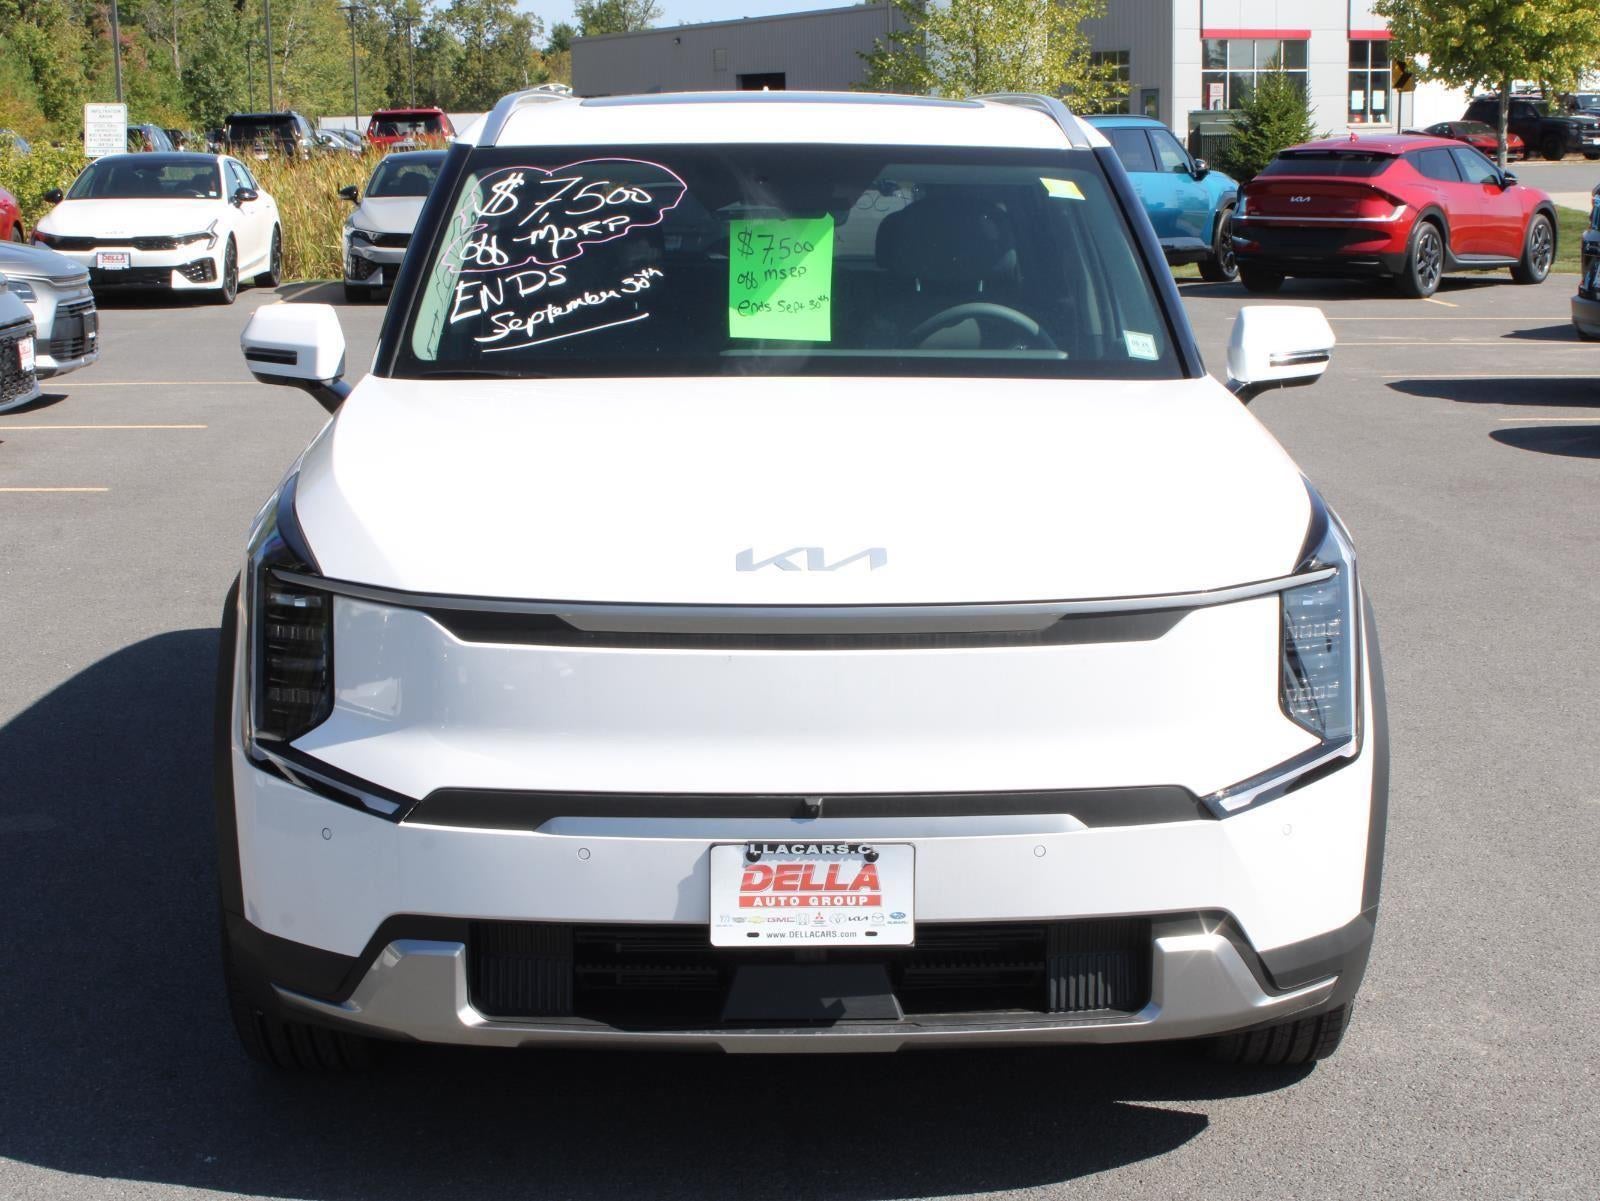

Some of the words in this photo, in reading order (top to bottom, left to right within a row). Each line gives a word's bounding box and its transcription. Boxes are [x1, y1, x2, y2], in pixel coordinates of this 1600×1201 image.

[449, 264, 568, 325] ENDS
[736, 546, 888, 572] KIA
[740, 863, 881, 893] DELLA
[752, 895, 800, 907] AUTO
[808, 895, 869, 907] GROUP
[766, 930, 857, 939] www.DELLACARS.com
